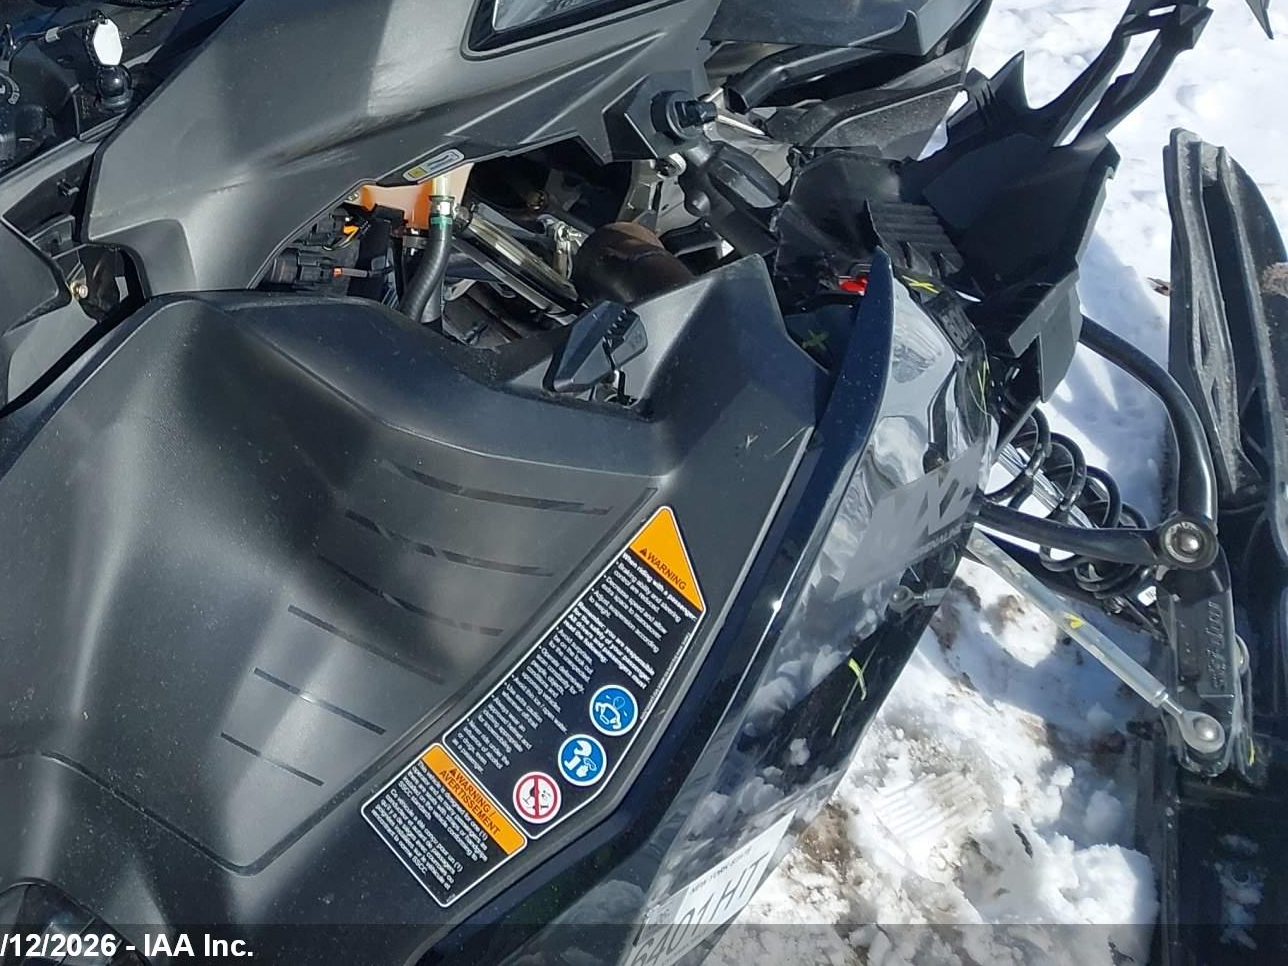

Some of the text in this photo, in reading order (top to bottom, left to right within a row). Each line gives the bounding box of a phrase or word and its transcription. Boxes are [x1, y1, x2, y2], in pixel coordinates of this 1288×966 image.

[612, 567, 661, 614] control are reduced.
[616, 561, 682, 624] Braking ability and steering
[621, 551, 665, 592] When riding with
[645, 551, 688, 590] WARNING
[587, 594, 612, 620] to weight.
[600, 581, 636, 615] extra space to
[605, 575, 668, 635] Decrease speed and allow
[557, 628, 573, 644] Avoid
[562, 618, 577, 633] read
[573, 629, 585, 641] the
[572, 606, 583, 617] for
[579, 613, 591, 625] the
[587, 621, 606, 641] safety
[603, 636, 612, 646] of
[608, 643, 623, 658] your
[592, 588, 660, 654] Adjust suspension according
[539, 646, 561, 668] Operate
[547, 639, 557, 649] for
[553, 645, 565, 657] the
[552, 633, 594, 675] be on the look out
[566, 612, 647, 689] All drivers and passengers must
[603, 627, 656, 677] you are responsible
[525, 663, 559, 699] conditions and
[534, 653, 578, 696] scan constantly for
[476, 713, 486, 723] for
[491, 695, 510, 715] Always
[506, 711, 520, 726] wear
[504, 683, 544, 724] Use extra caution
[512, 675, 528, 691] Avoid
[524, 687, 536, 699] thin
[532, 696, 542, 706] ice
[540, 706, 555, 721] open
[456, 731, 464, 740] or
[473, 750, 488, 765] even
[461, 725, 504, 770] influence of alcohol
[467, 719, 511, 766] Never ride under the
[480, 707, 524, 754] clothing appropriate
[486, 701, 533, 750] approved helmet and
[396, 780, 413, 797] SSCC
[410, 764, 488, 851] operator and as many passengers as
[416, 760, 488, 842] This vehicle designed for one (1)
[437, 767, 501, 836] AVERTISSEMENT
[454, 772, 492, 813] WARNING
[384, 793, 409, 821] conducteur
[406, 818, 414, 827] et
[411, 824, 427, 842] autant
[424, 839, 433, 849] de
[389, 788, 400, 799] Ce
[422, 827, 439, 845] conçu
[435, 842, 449, 857] pour
[446, 853, 456, 864] un
[452, 860, 464, 873] (1)
[401, 775, 478, 862] installed on the vehicle conforming to
[406, 770, 489, 863] there are seats with or handgrips
[394, 816, 404, 825] de
[414, 839, 428, 853] avec
[445, 874, 454, 884] ou
[396, 840, 413, 858] norme
[412, 847, 422, 857] sur
[419, 855, 427, 863] le
[442, 881, 451, 890] et
